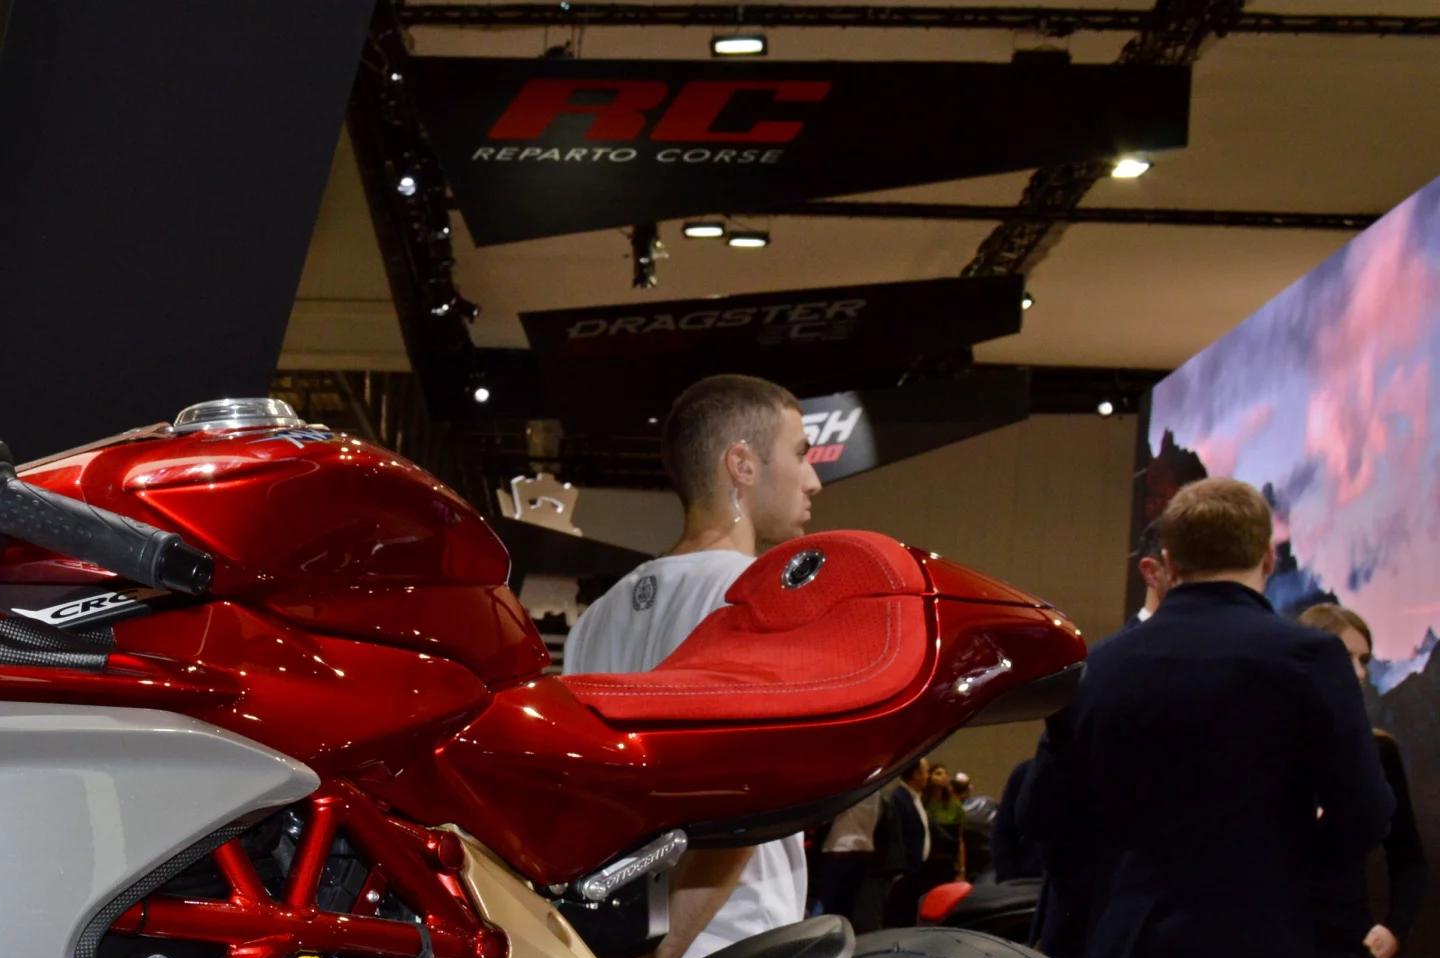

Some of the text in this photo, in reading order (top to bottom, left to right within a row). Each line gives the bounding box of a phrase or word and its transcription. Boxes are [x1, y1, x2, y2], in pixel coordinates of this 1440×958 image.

[487, 77, 832, 143] RC
[471, 146, 785, 164] REPARTO CORSE
[567, 297, 868, 340] DRAGSTER
[801, 406, 863, 446] SH
[50, 588, 140, 619] CRC
